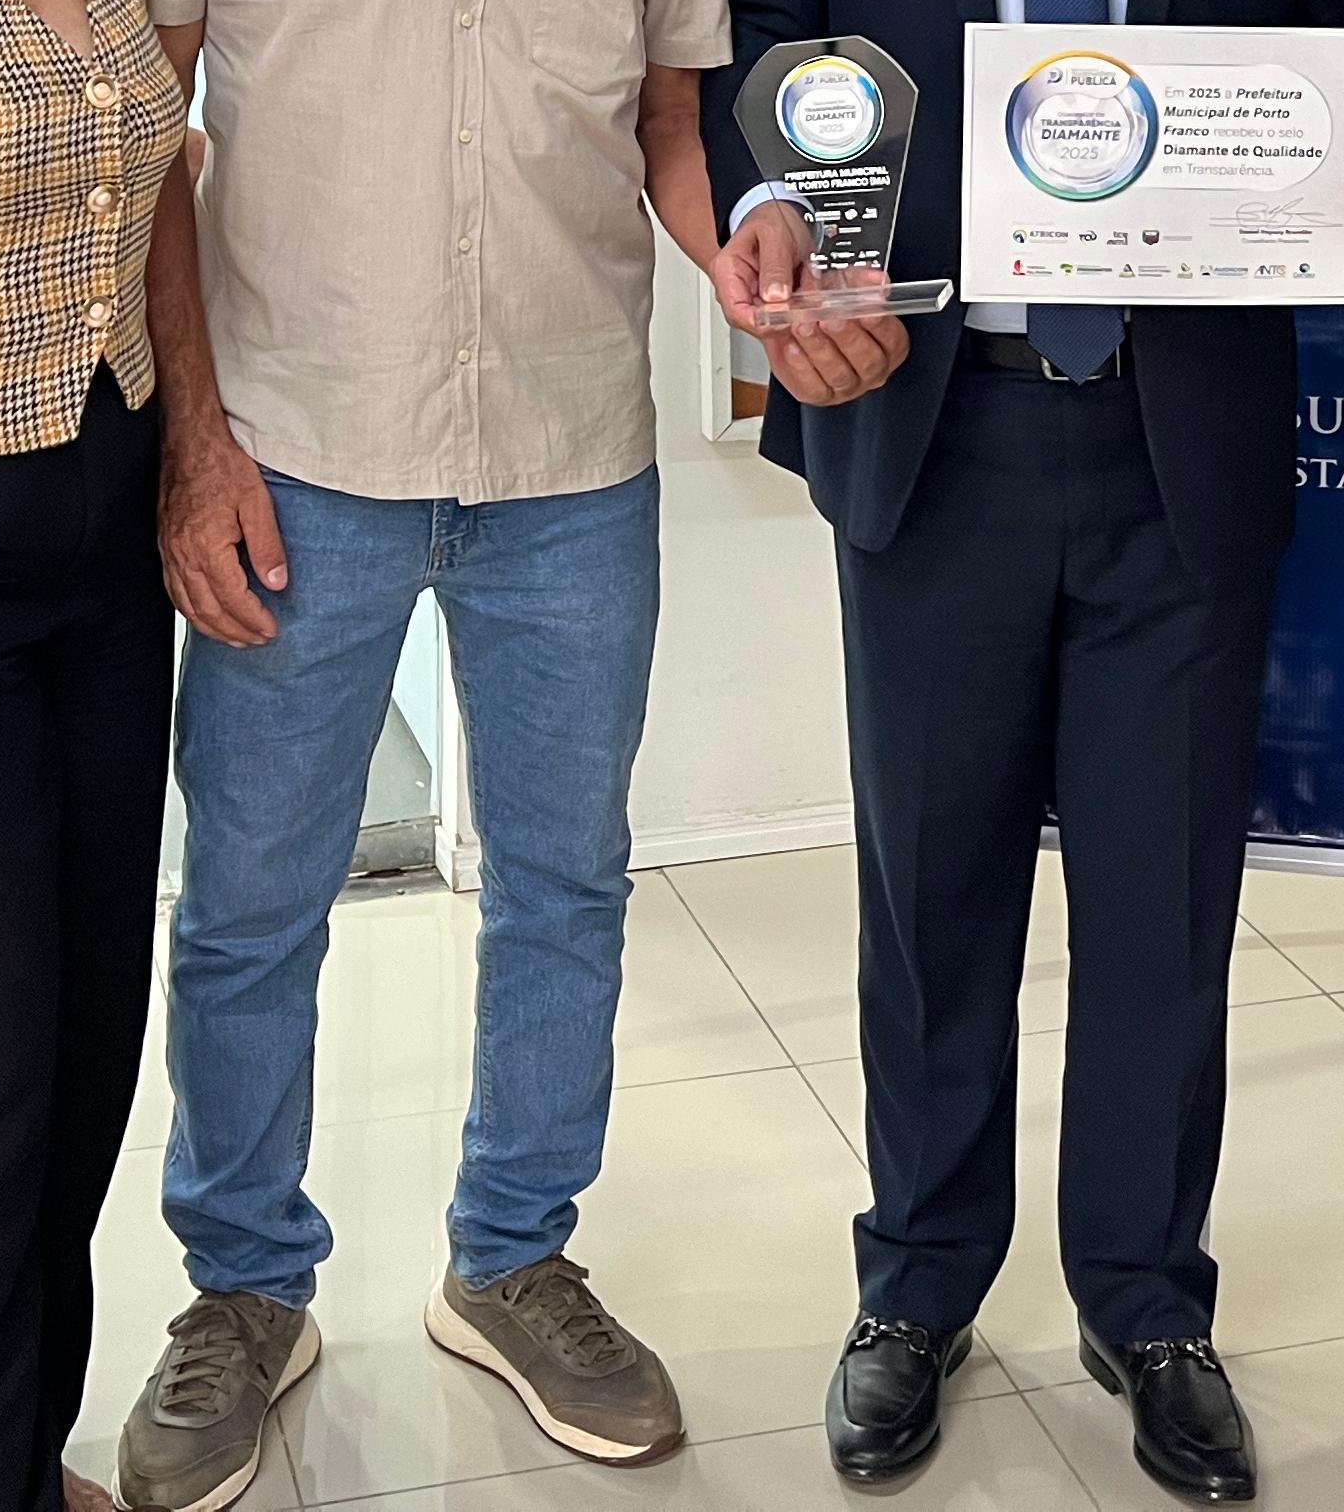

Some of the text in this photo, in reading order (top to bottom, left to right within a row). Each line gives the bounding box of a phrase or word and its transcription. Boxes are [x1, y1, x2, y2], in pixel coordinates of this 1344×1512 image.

[1164, 87, 1185, 98] Em
[1188, 88, 1221, 99] 2025
[1236, 88, 1303, 100] Prefeitura
[805, 111, 856, 122] DIAMANTE
[1163, 106, 1290, 120] Municipal de Porto
[818, 123, 845, 134] 2025
[1041, 129, 1122, 141] DIAMANTE
[1163, 125, 1304, 138] Franco recebeu o selo
[1059, 146, 1099, 160] 2025
[1163, 144, 1323, 158] Diamante de Qualidade
[784, 166, 889, 181] PREFEITURA MUNICIPAL
[1162, 165, 1183, 174] em
[798, 180, 830, 190] PORTO
[830, 178, 869, 188] FRANCO
